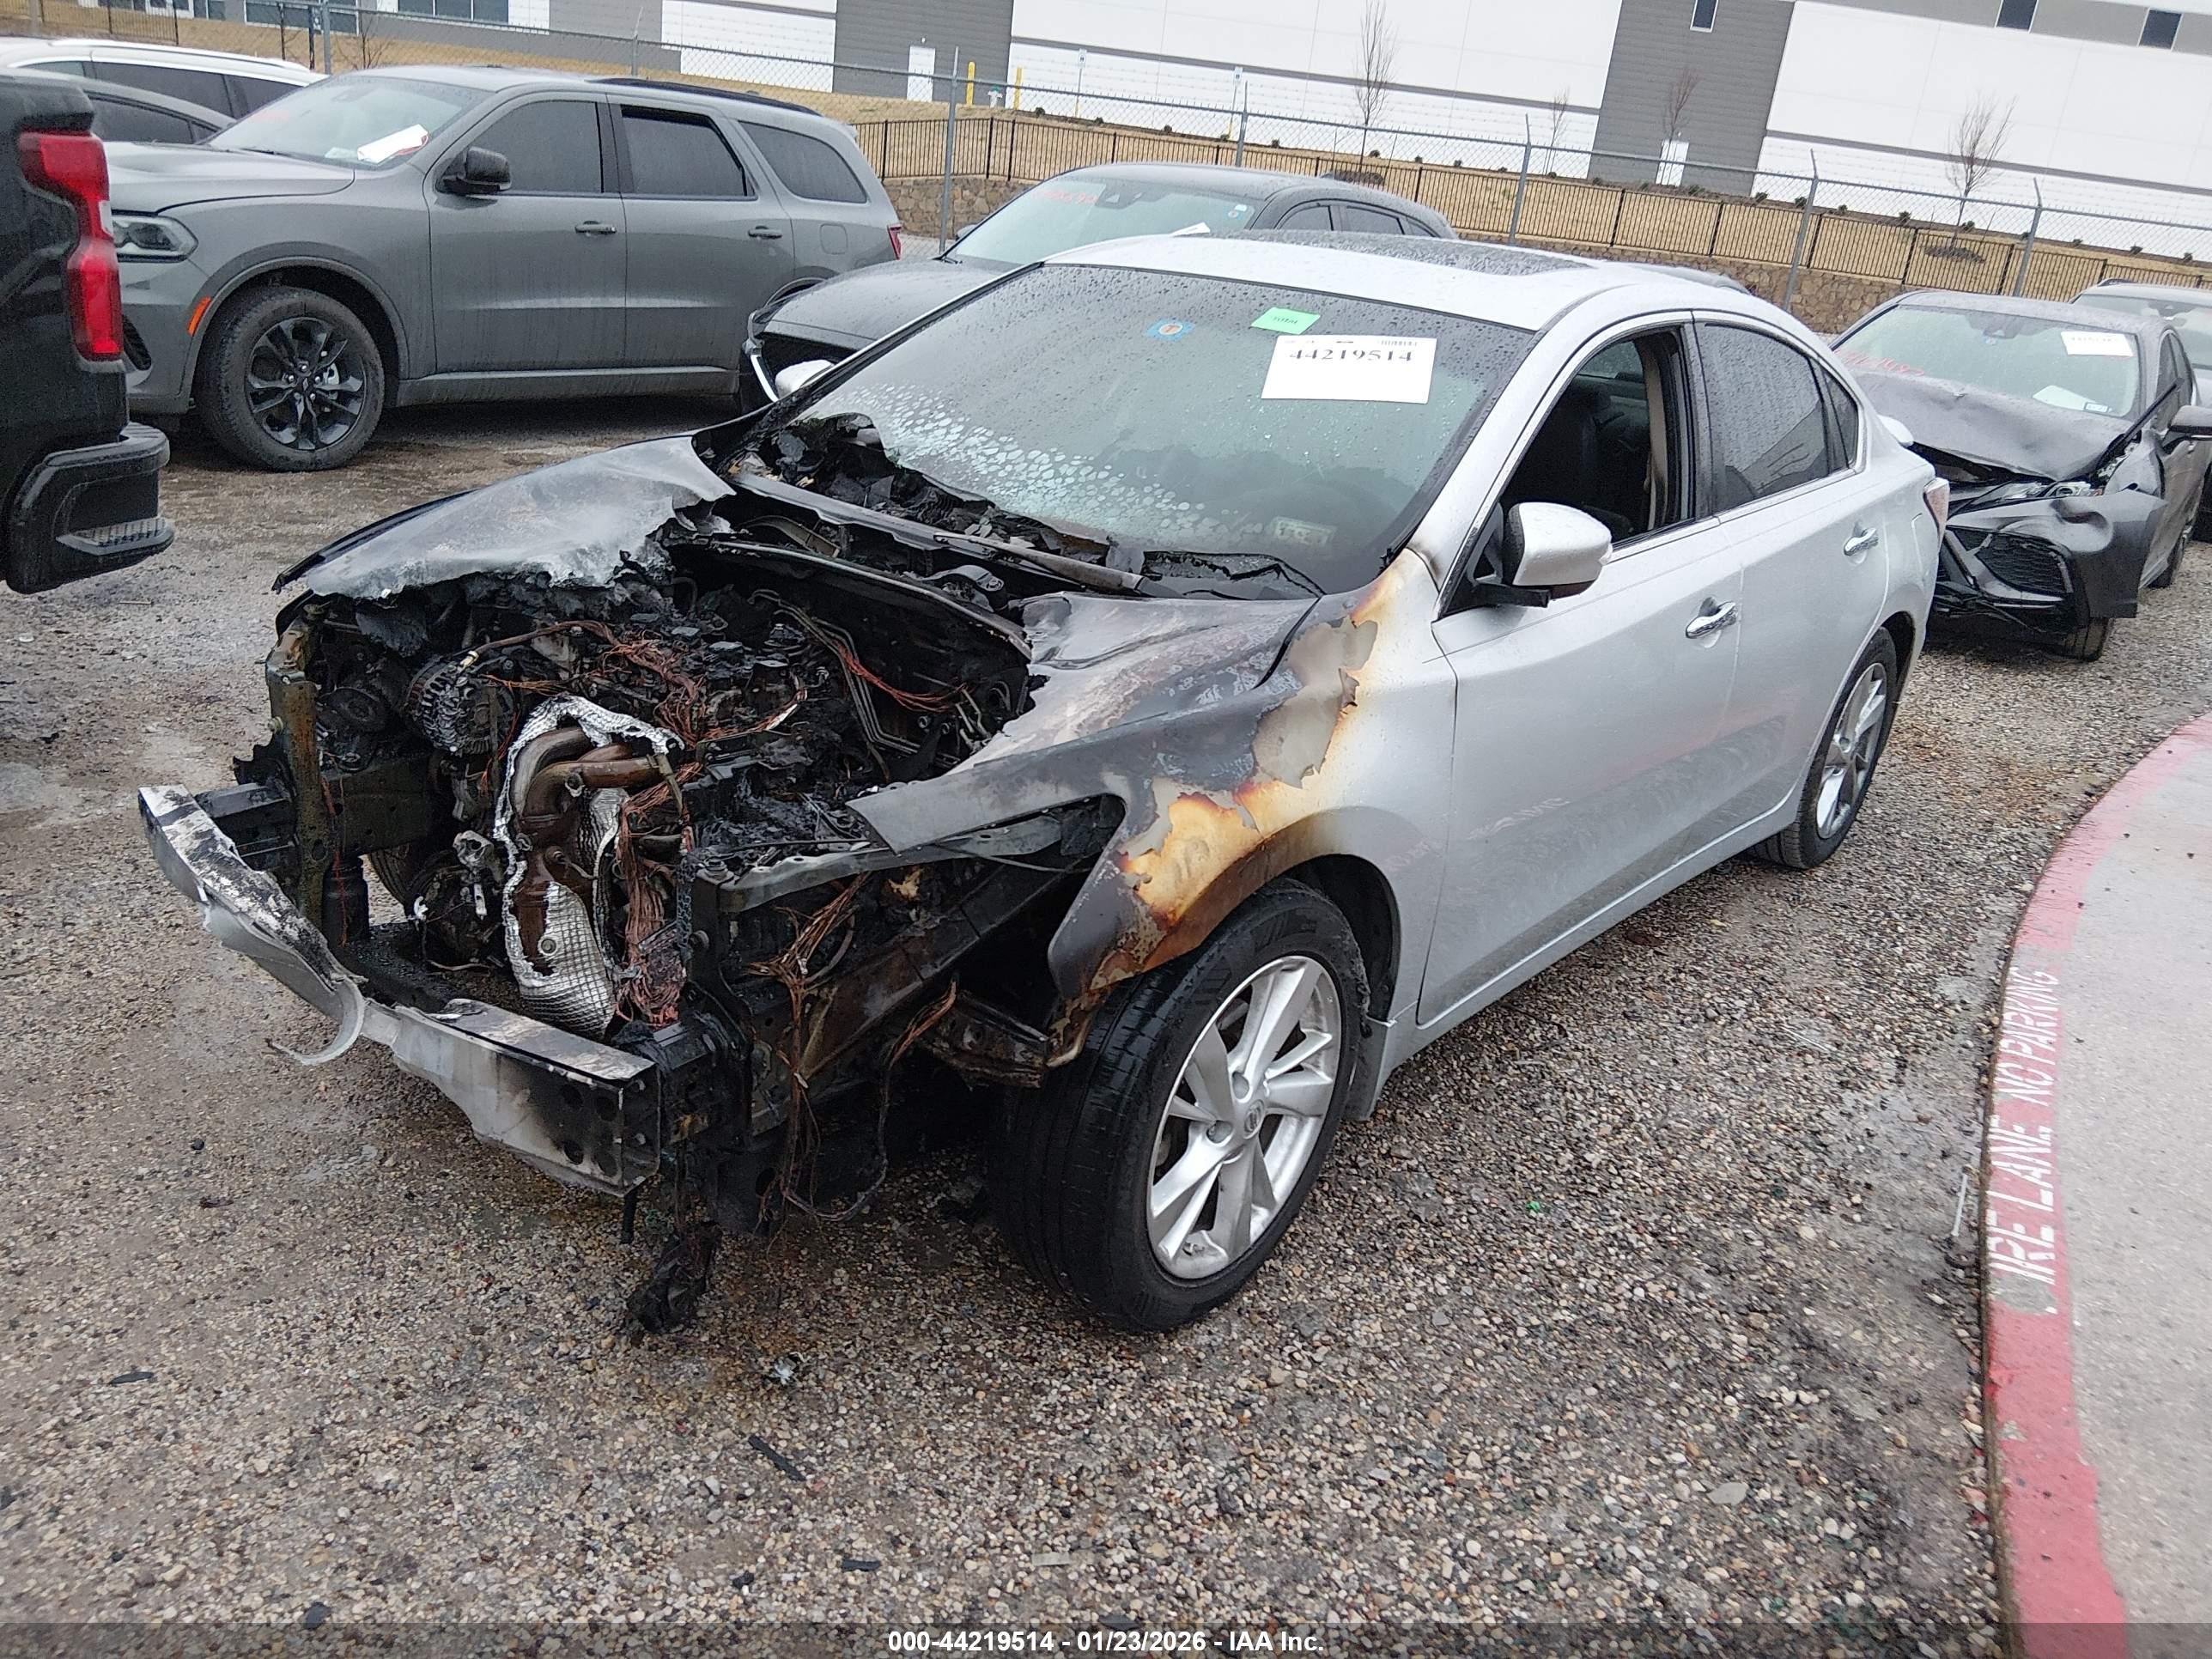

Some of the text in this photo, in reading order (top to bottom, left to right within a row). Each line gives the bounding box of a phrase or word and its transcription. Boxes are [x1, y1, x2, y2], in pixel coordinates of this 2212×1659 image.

[1289, 349, 1413, 361] 44219514
[1997, 967, 2060, 1066] PARKING
[1992, 1061, 2055, 1107] NO
[1985, 1115, 2055, 1212] LANE
